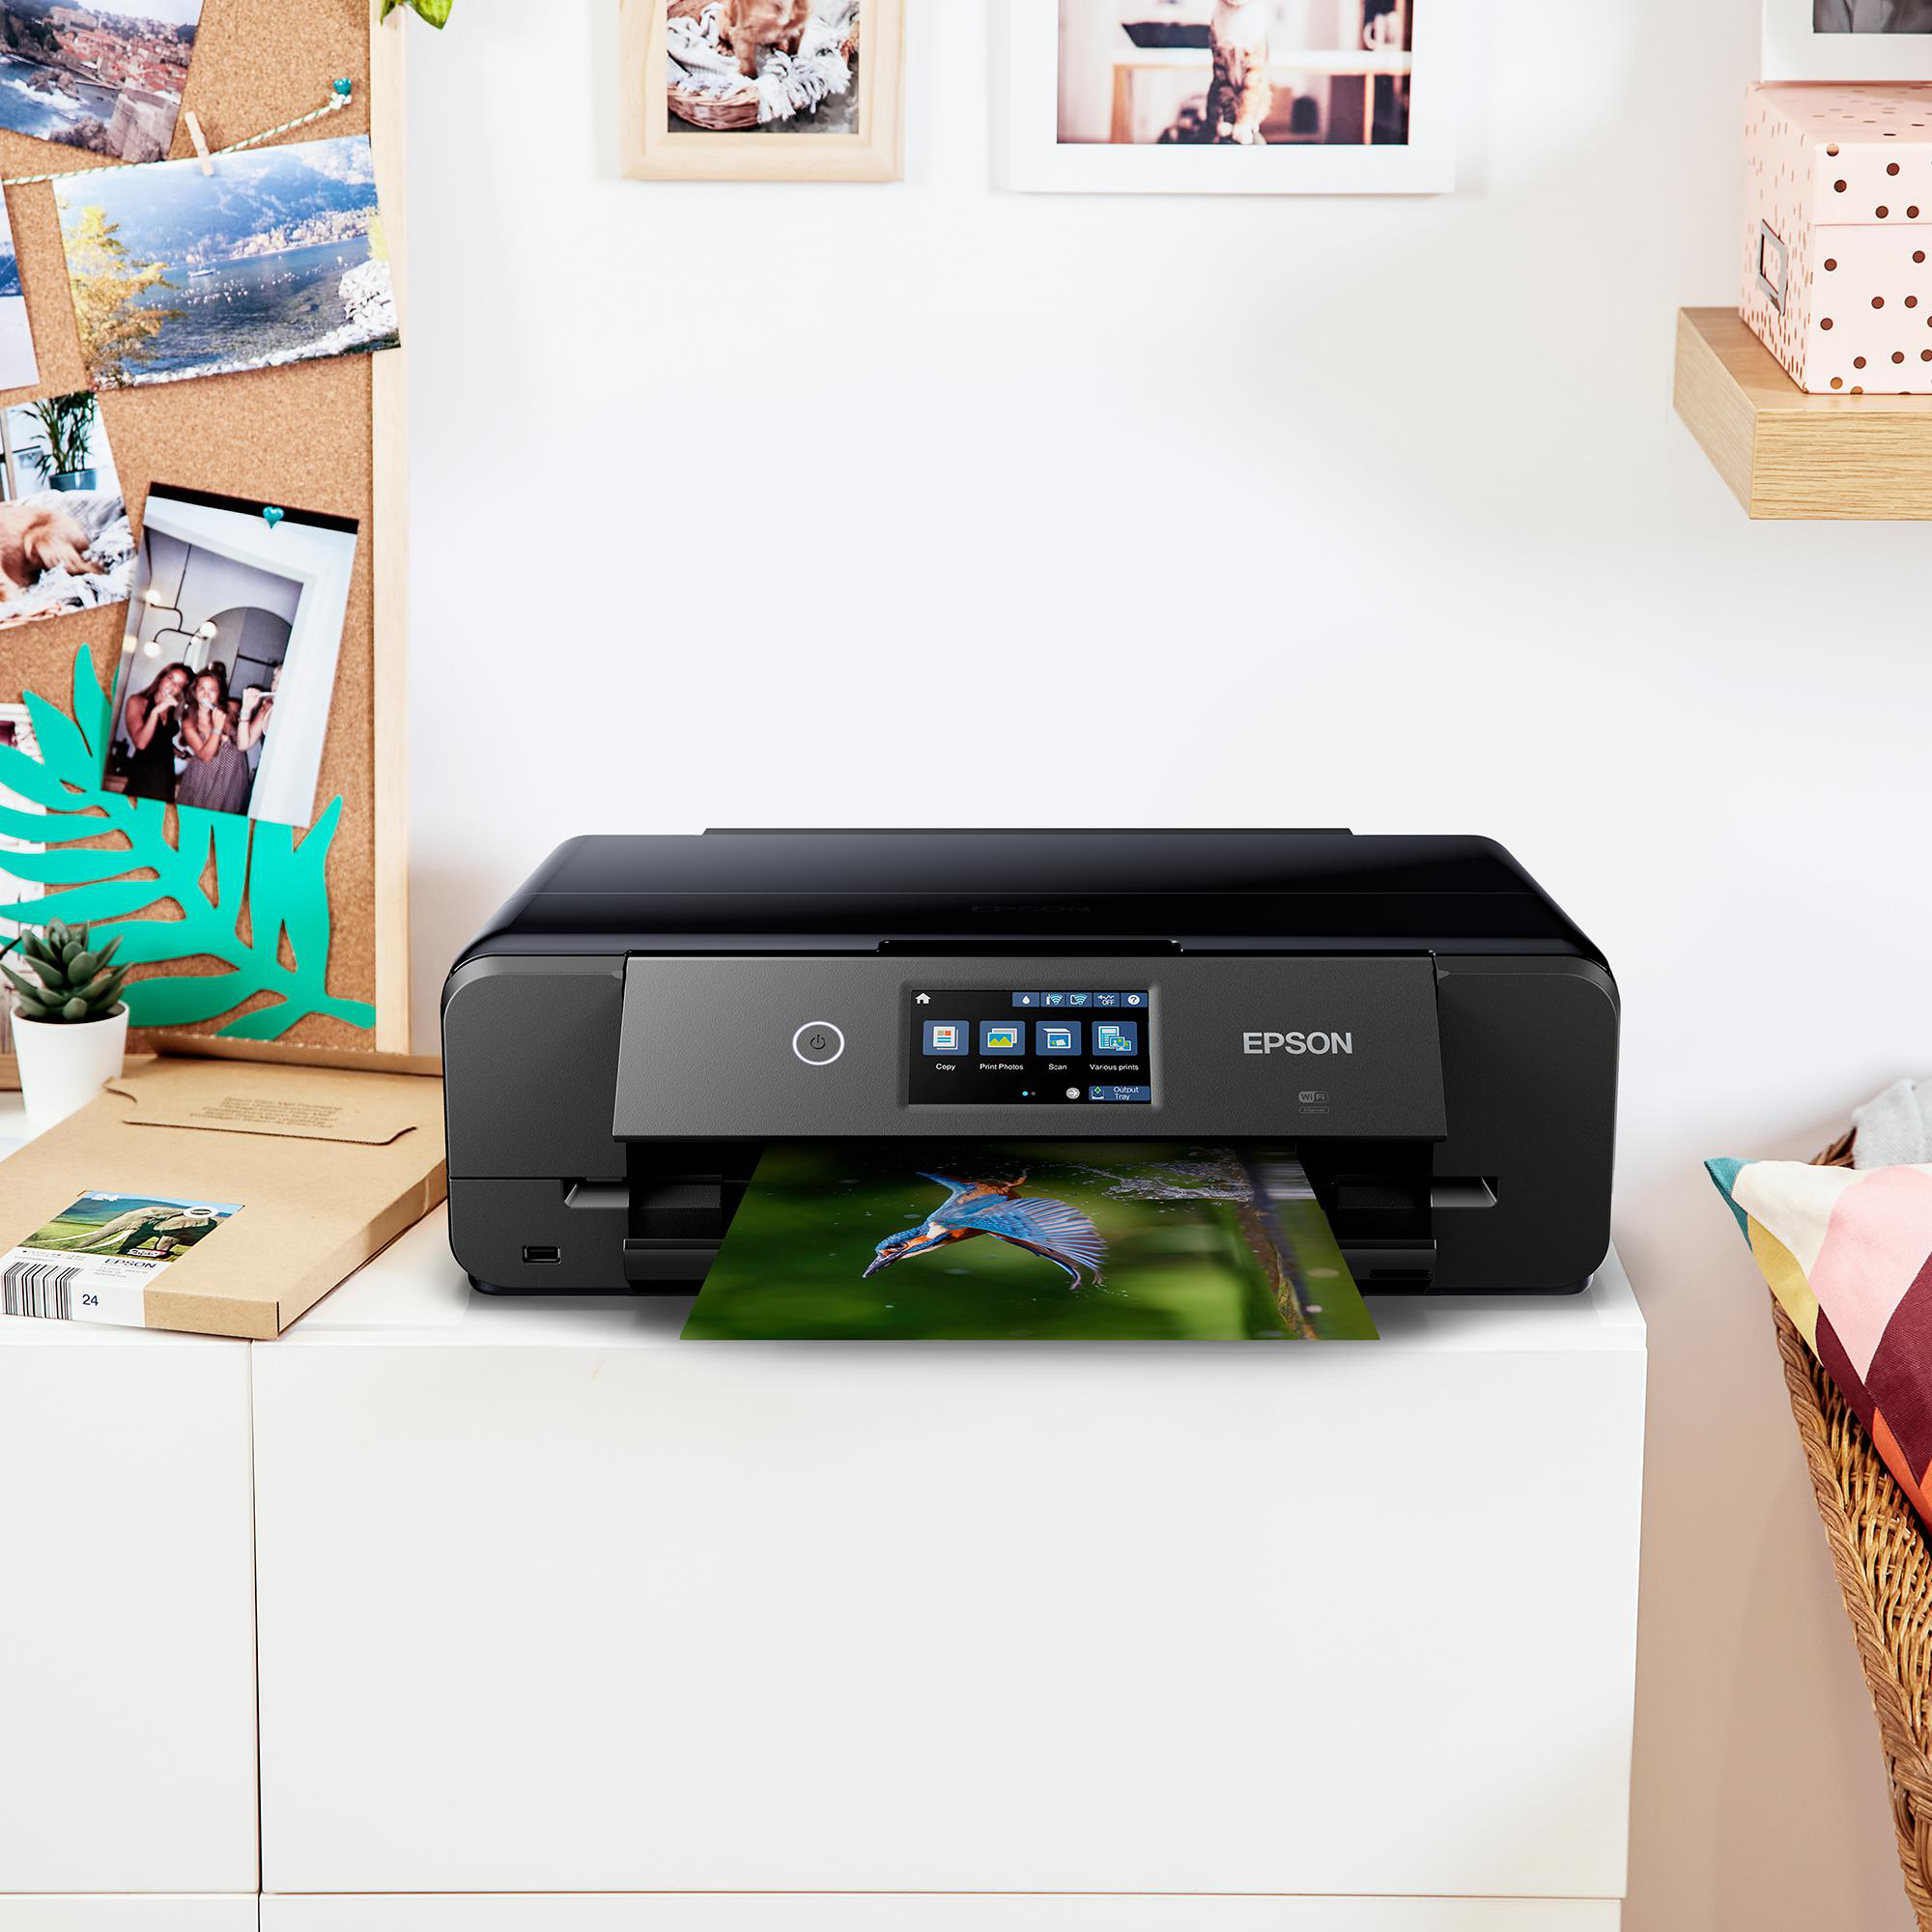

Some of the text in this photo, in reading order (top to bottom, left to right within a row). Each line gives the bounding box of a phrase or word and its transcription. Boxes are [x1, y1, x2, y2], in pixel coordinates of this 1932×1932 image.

[1242, 1031, 1353, 1055] EPSON
[935, 1063, 956, 1071] Copy
[104, 1258, 156, 1268] EPSON
[82, 1293, 99, 1307] 24
